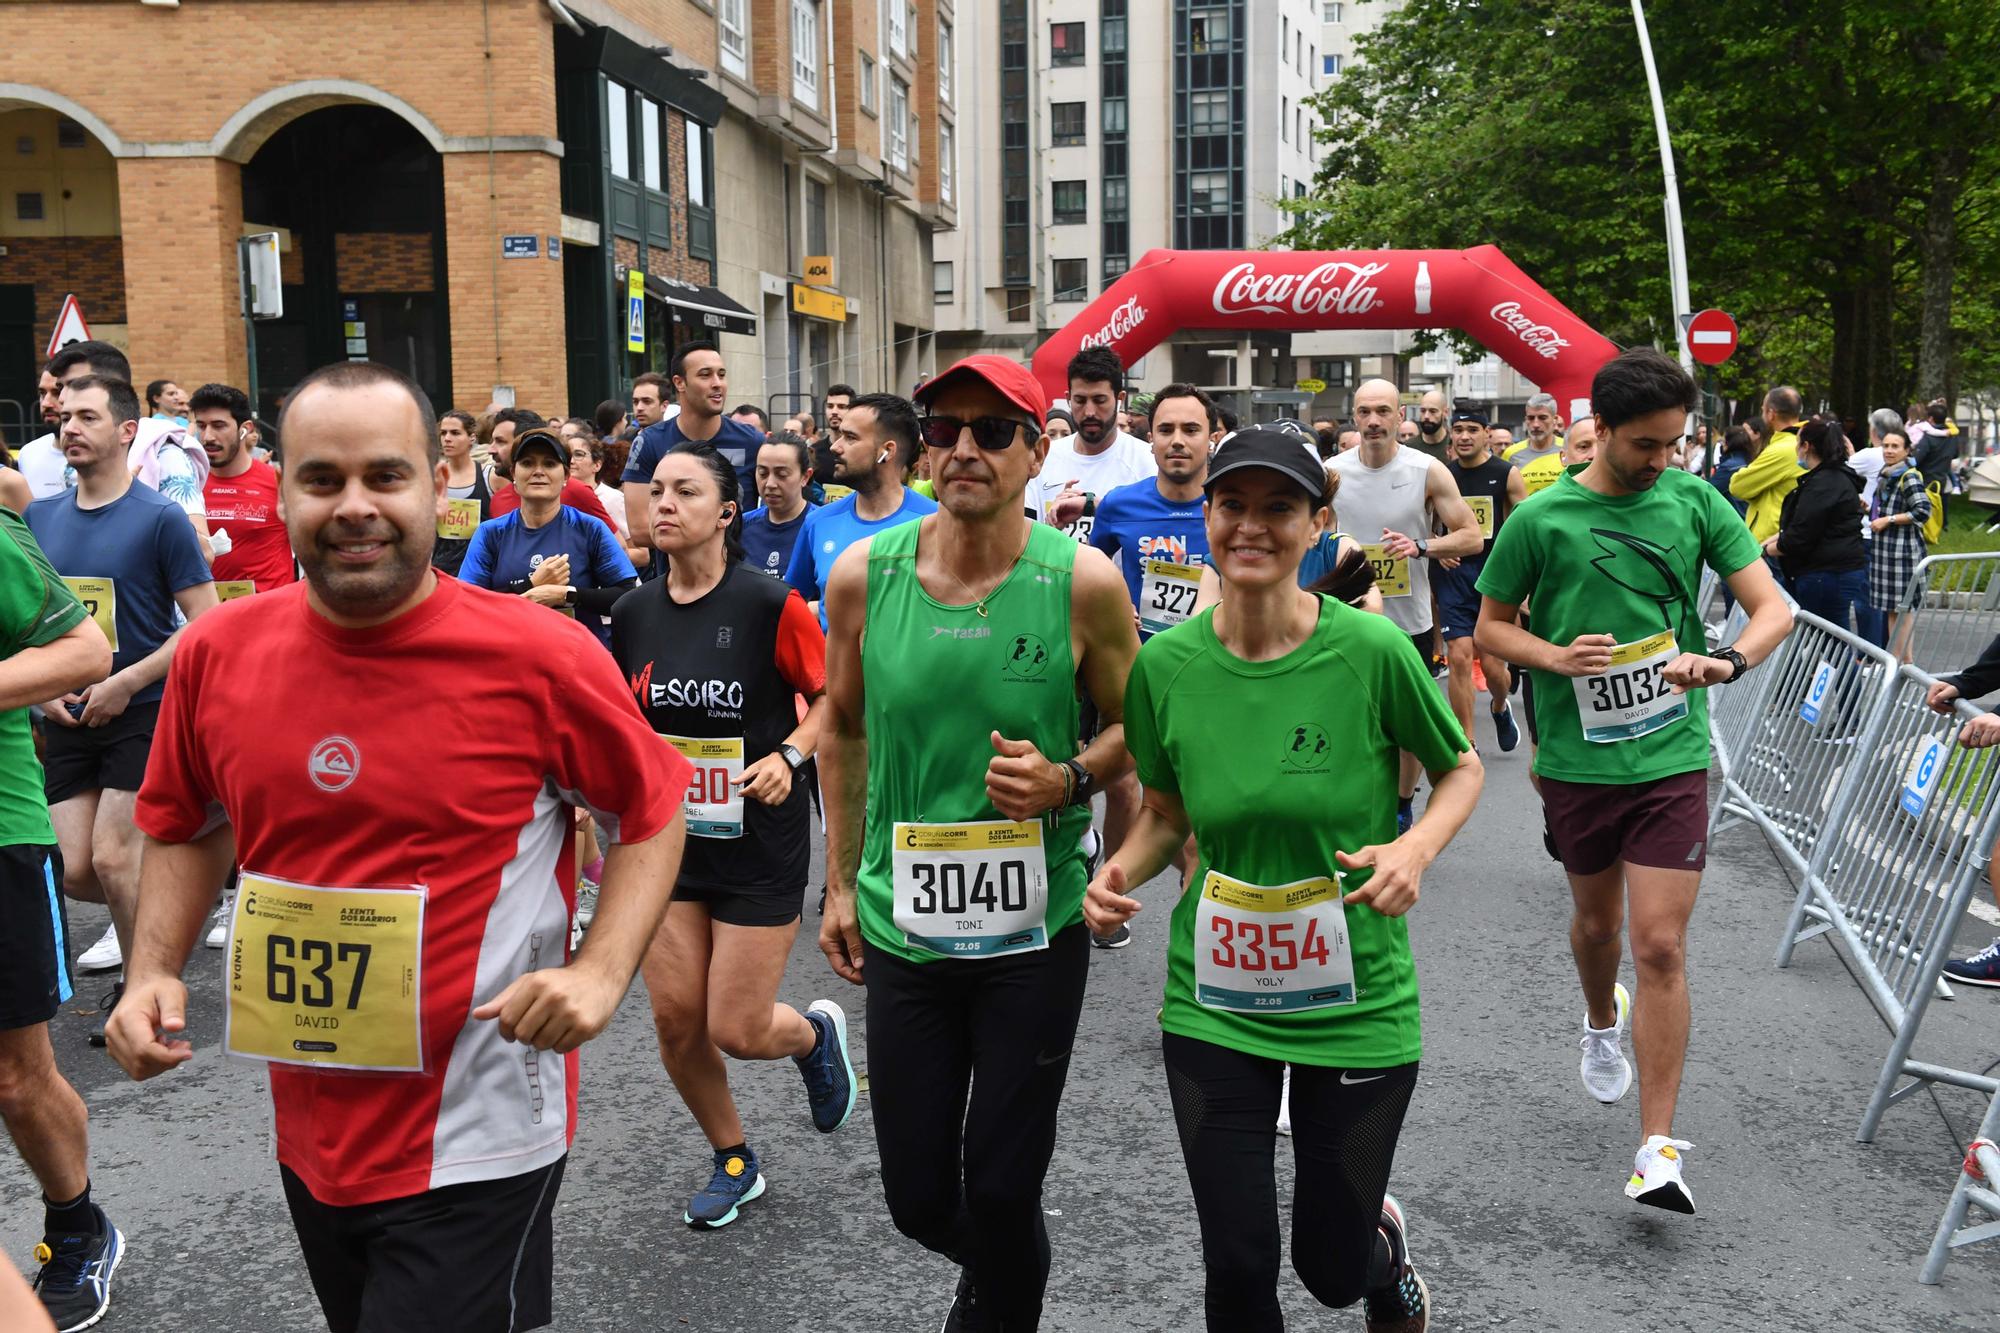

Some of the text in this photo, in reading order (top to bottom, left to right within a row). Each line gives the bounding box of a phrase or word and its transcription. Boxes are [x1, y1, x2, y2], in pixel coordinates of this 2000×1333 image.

[809, 266, 827, 276] 404
[1212, 262, 1389, 315] Coca-Cola
[1080, 294, 1145, 352] Coca-Cola
[1490, 301, 1571, 358] Coca-Cola
[1138, 536, 1187, 554] SAN
[631, 660, 743, 709] MESOIRO
[1588, 660, 1671, 712] 3032
[707, 709, 741, 720] RUNNING
[1624, 707, 1649, 720] DAVID
[912, 860, 1027, 914] 3040
[259, 895, 313, 911] CORUÑACORRE
[340, 914, 397, 923] DOS BARRIOS
[349, 908, 376, 916] XENTE
[955, 920, 983, 930] TONI
[954, 942, 980, 951] 22.05
[1212, 915, 1329, 971] 3354
[233, 939, 243, 992] TANDA 2
[267, 934, 372, 1010] 637
[1255, 977, 1285, 987] YOLY
[1254, 997, 1282, 1006] 22.05
[295, 1014, 339, 1030] DAVID
